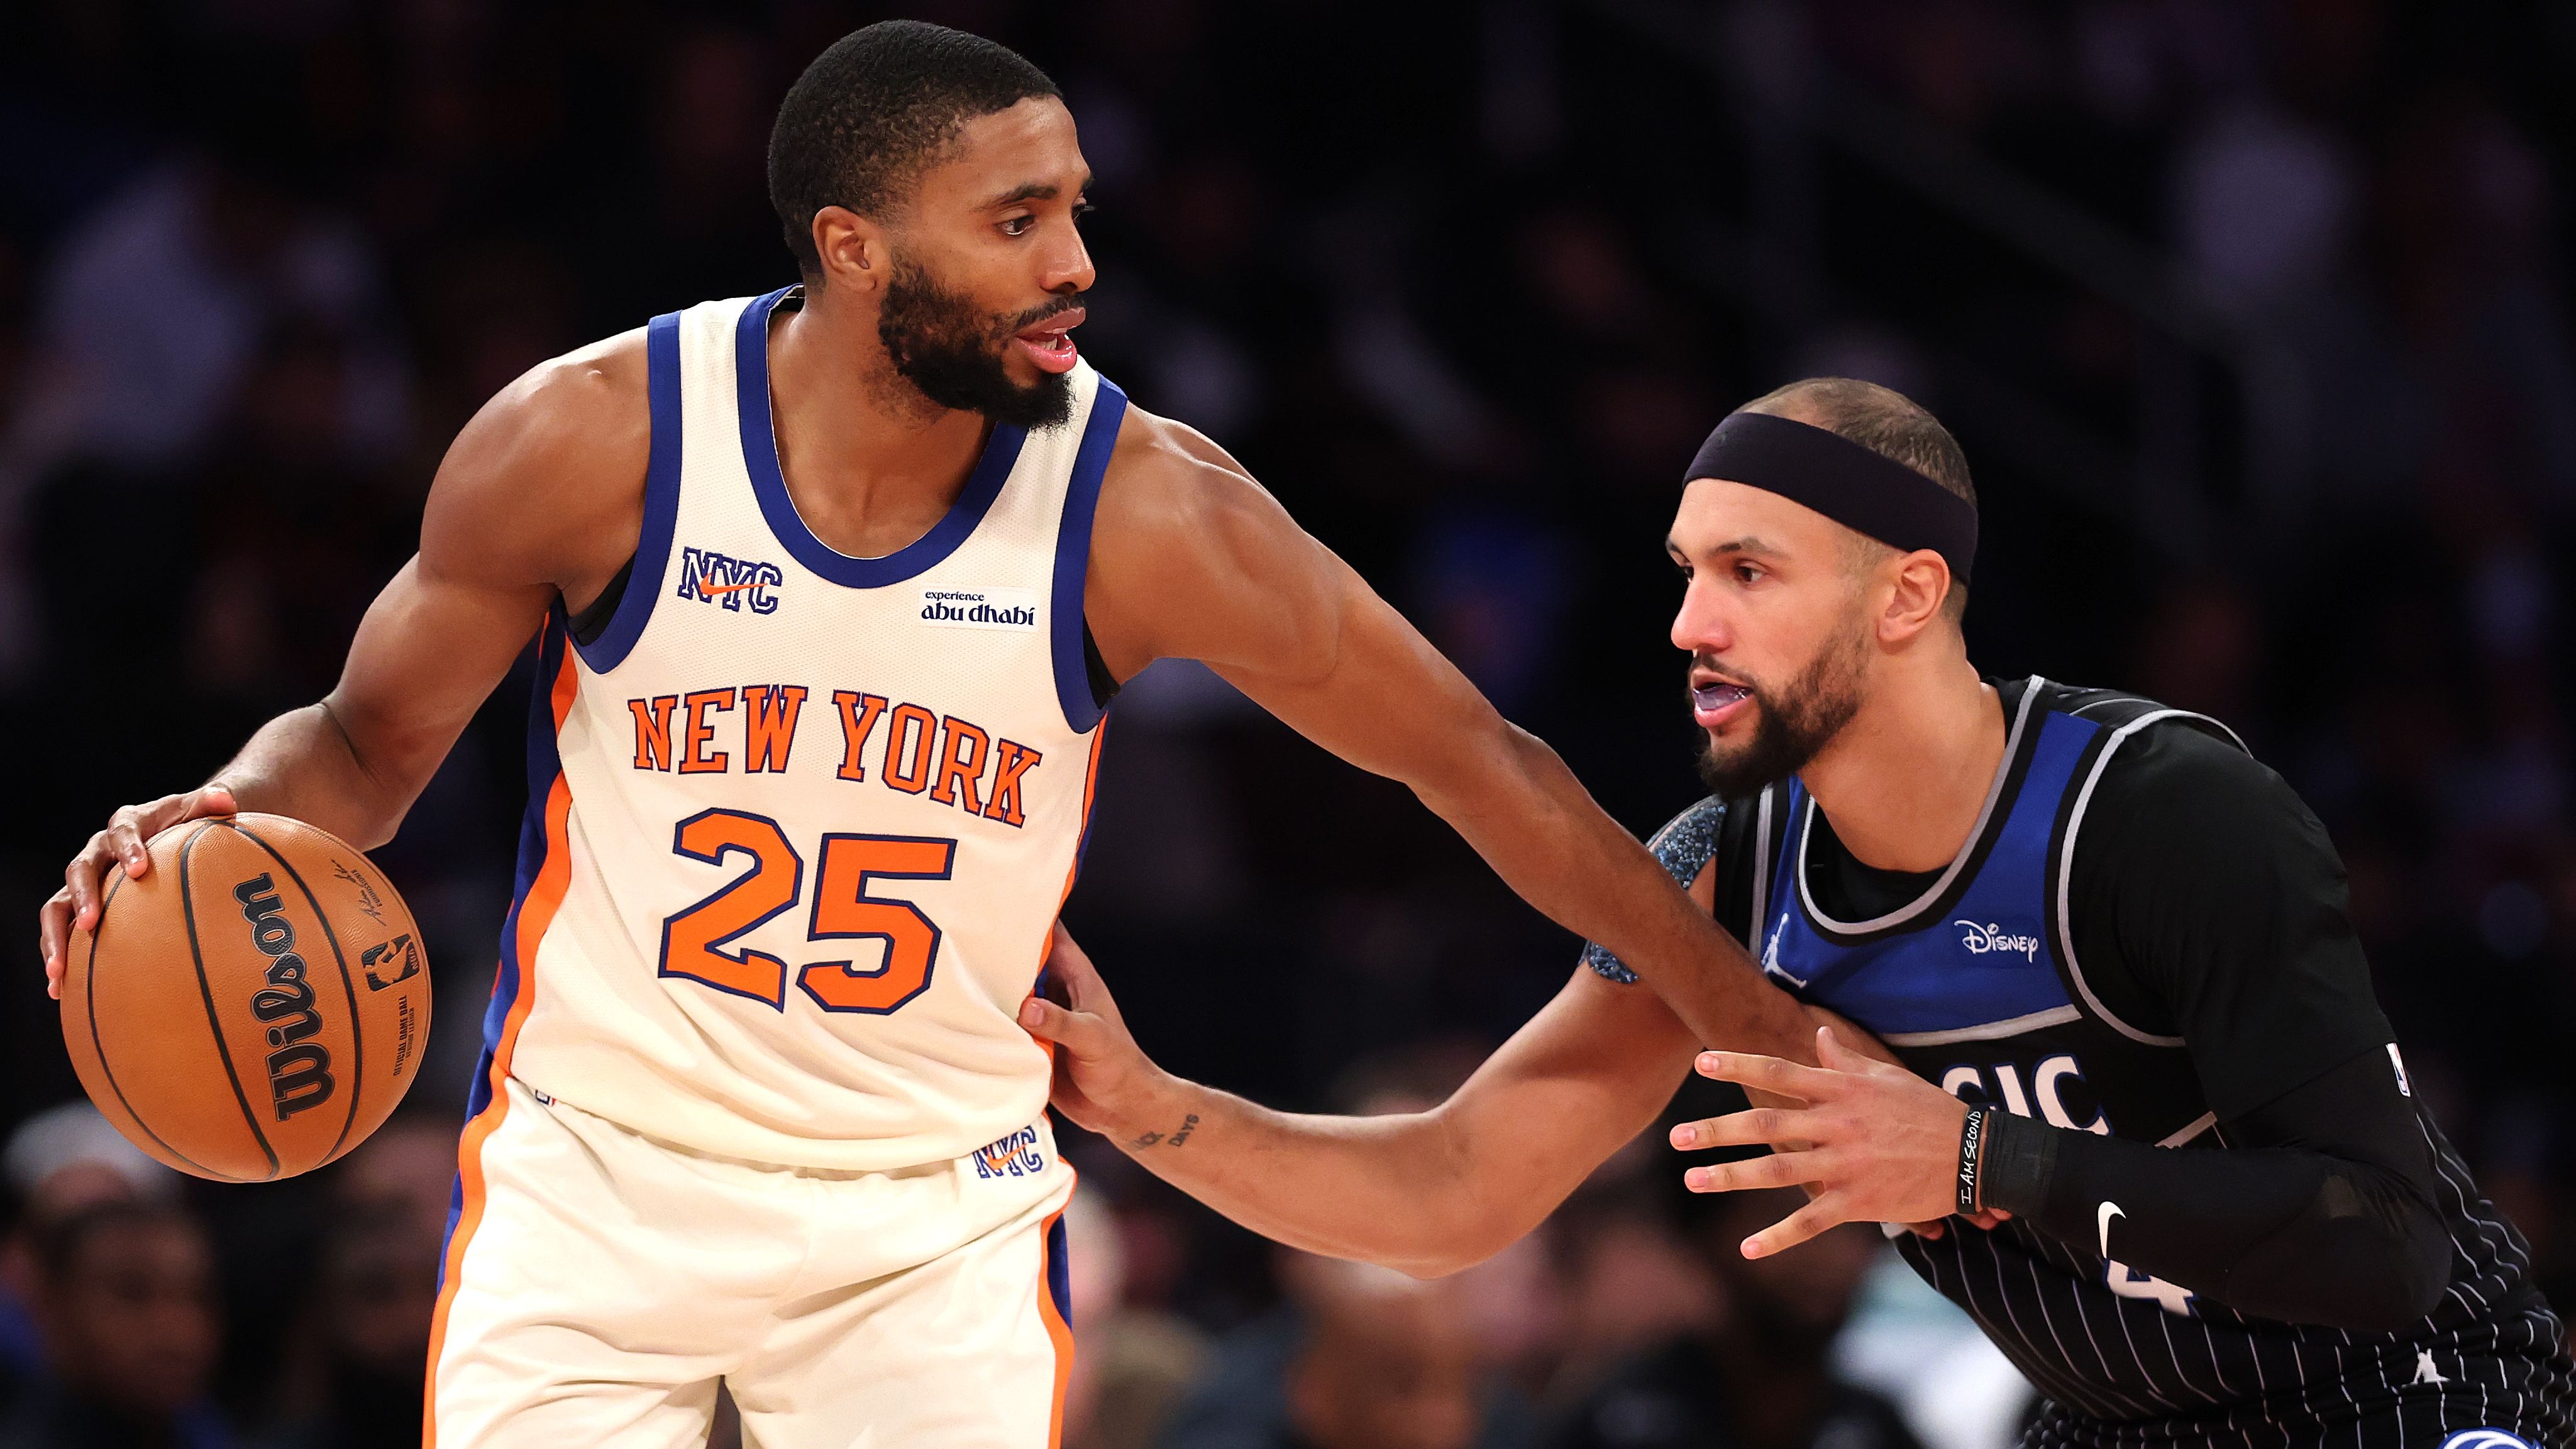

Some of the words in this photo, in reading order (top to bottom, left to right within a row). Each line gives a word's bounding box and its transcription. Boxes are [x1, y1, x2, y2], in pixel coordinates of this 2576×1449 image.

[678, 546, 782, 615] NYC
[926, 590, 985, 602] experience
[921, 601, 965, 623] abu
[968, 602, 1035, 626] dhabi
[629, 685, 809, 774] NEW
[832, 690, 1042, 828] YORK
[658, 807, 958, 1015] 25
[233, 872, 336, 1121] Wilson
[398, 994, 407, 1017] BALL
[399, 1018, 407, 1040] GAME
[393, 1040, 407, 1076] OFFICIAL
[972, 1124, 1044, 1179] NYC
[1963, 1111, 1982, 1160] SECOND
[1959, 1160, 1974, 1186] AM
[1960, 1187, 1972, 1204] I
